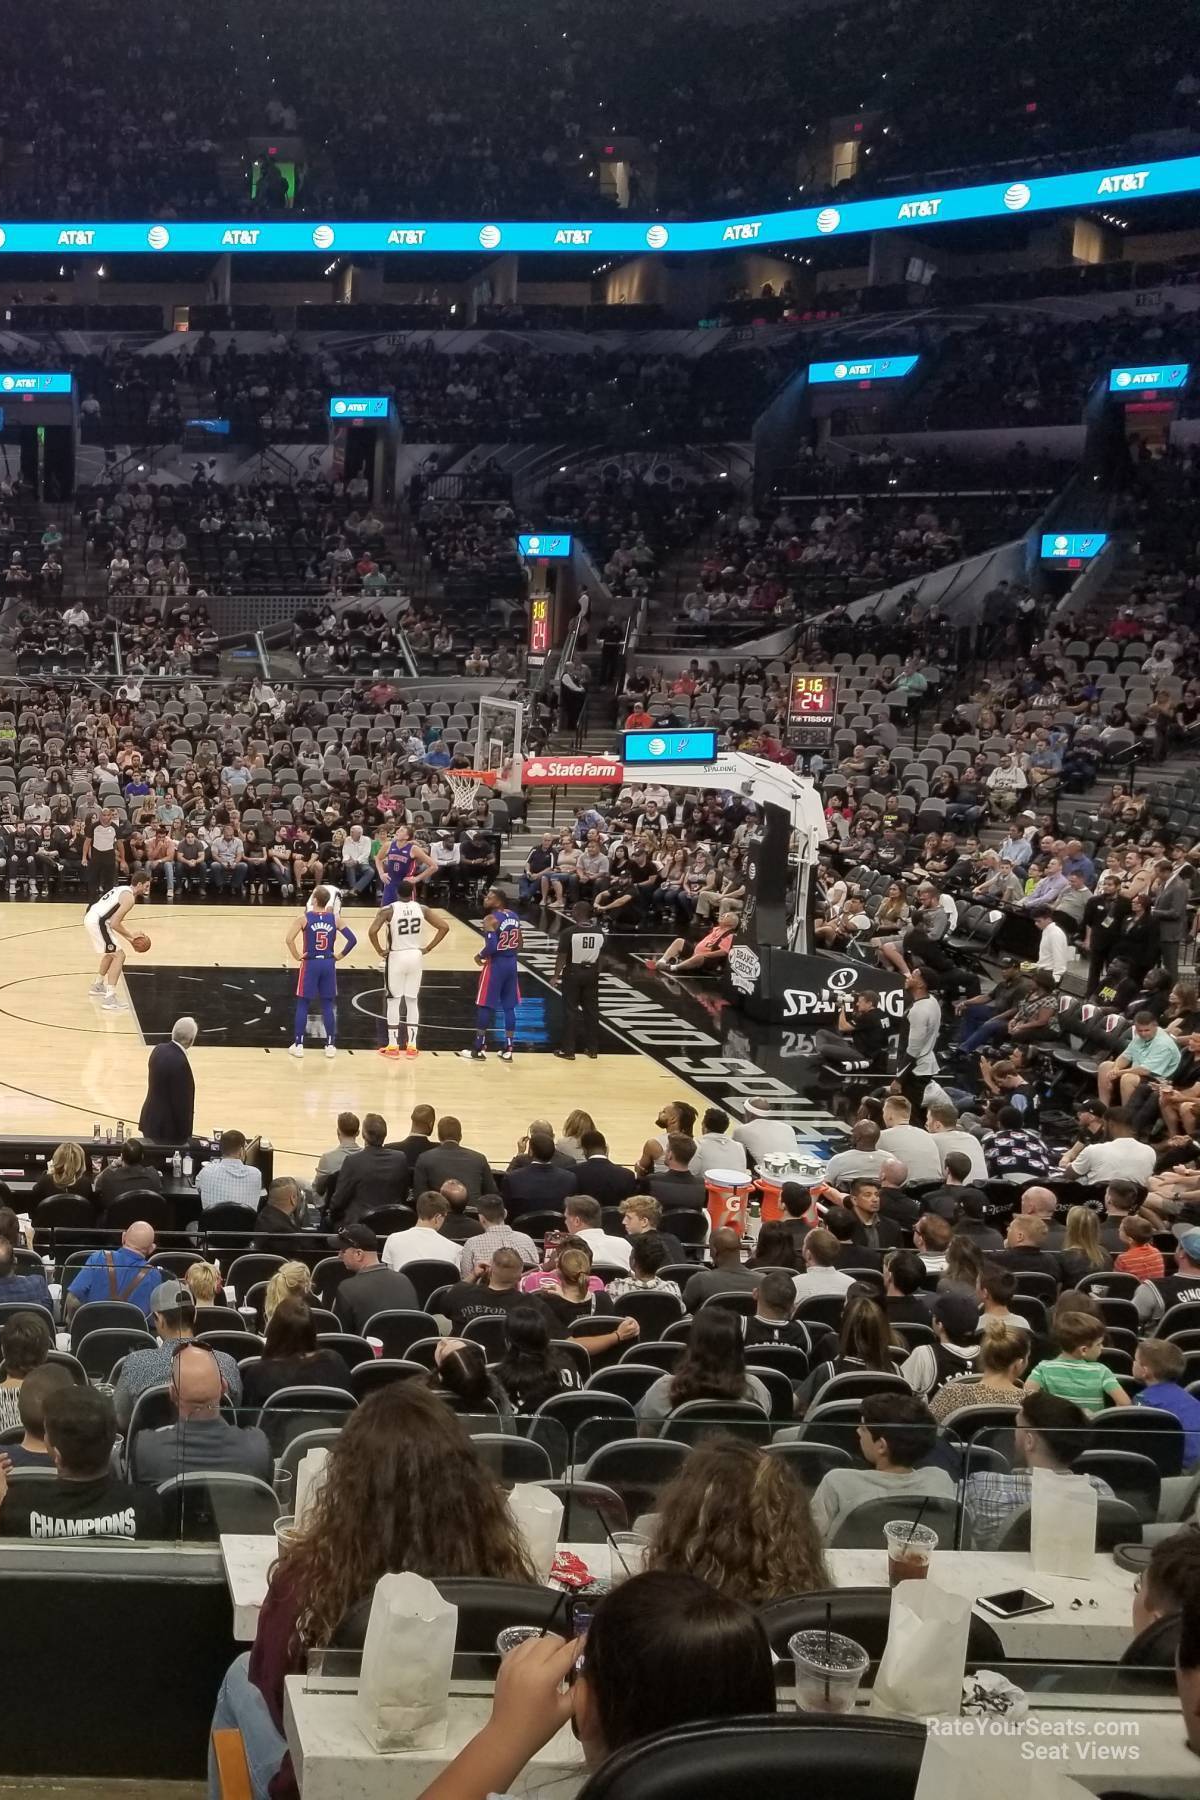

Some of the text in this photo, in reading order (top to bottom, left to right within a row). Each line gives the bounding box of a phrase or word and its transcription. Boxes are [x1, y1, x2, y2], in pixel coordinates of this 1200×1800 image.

[1098, 172, 1149, 194] AT&T
[898, 199, 942, 219] AT&T
[57, 230, 95, 245] AT&T
[222, 231, 260, 245] AT&T
[387, 230, 426, 245] AT&T
[554, 230, 593, 245] AT&T
[722, 222, 762, 241] AT&T
[848, 364, 872, 375] AT&T
[15, 378, 37, 388] AT&T
[1132, 373, 1159, 383] AT&T
[347, 403, 368, 412] AT&T
[533, 620, 546, 650] 24
[801, 692, 824, 709] 24
[803, 715, 834, 723] TISSOT
[703, 764, 737, 774] SPALDING
[397, 917, 422, 935] 22
[315, 931, 329, 951] 5
[496, 928, 519, 951] 22
[582, 936, 595, 949] 60
[725, 1196, 741, 1212] G
[29, 1507, 137, 1539] CHAMPIONS
